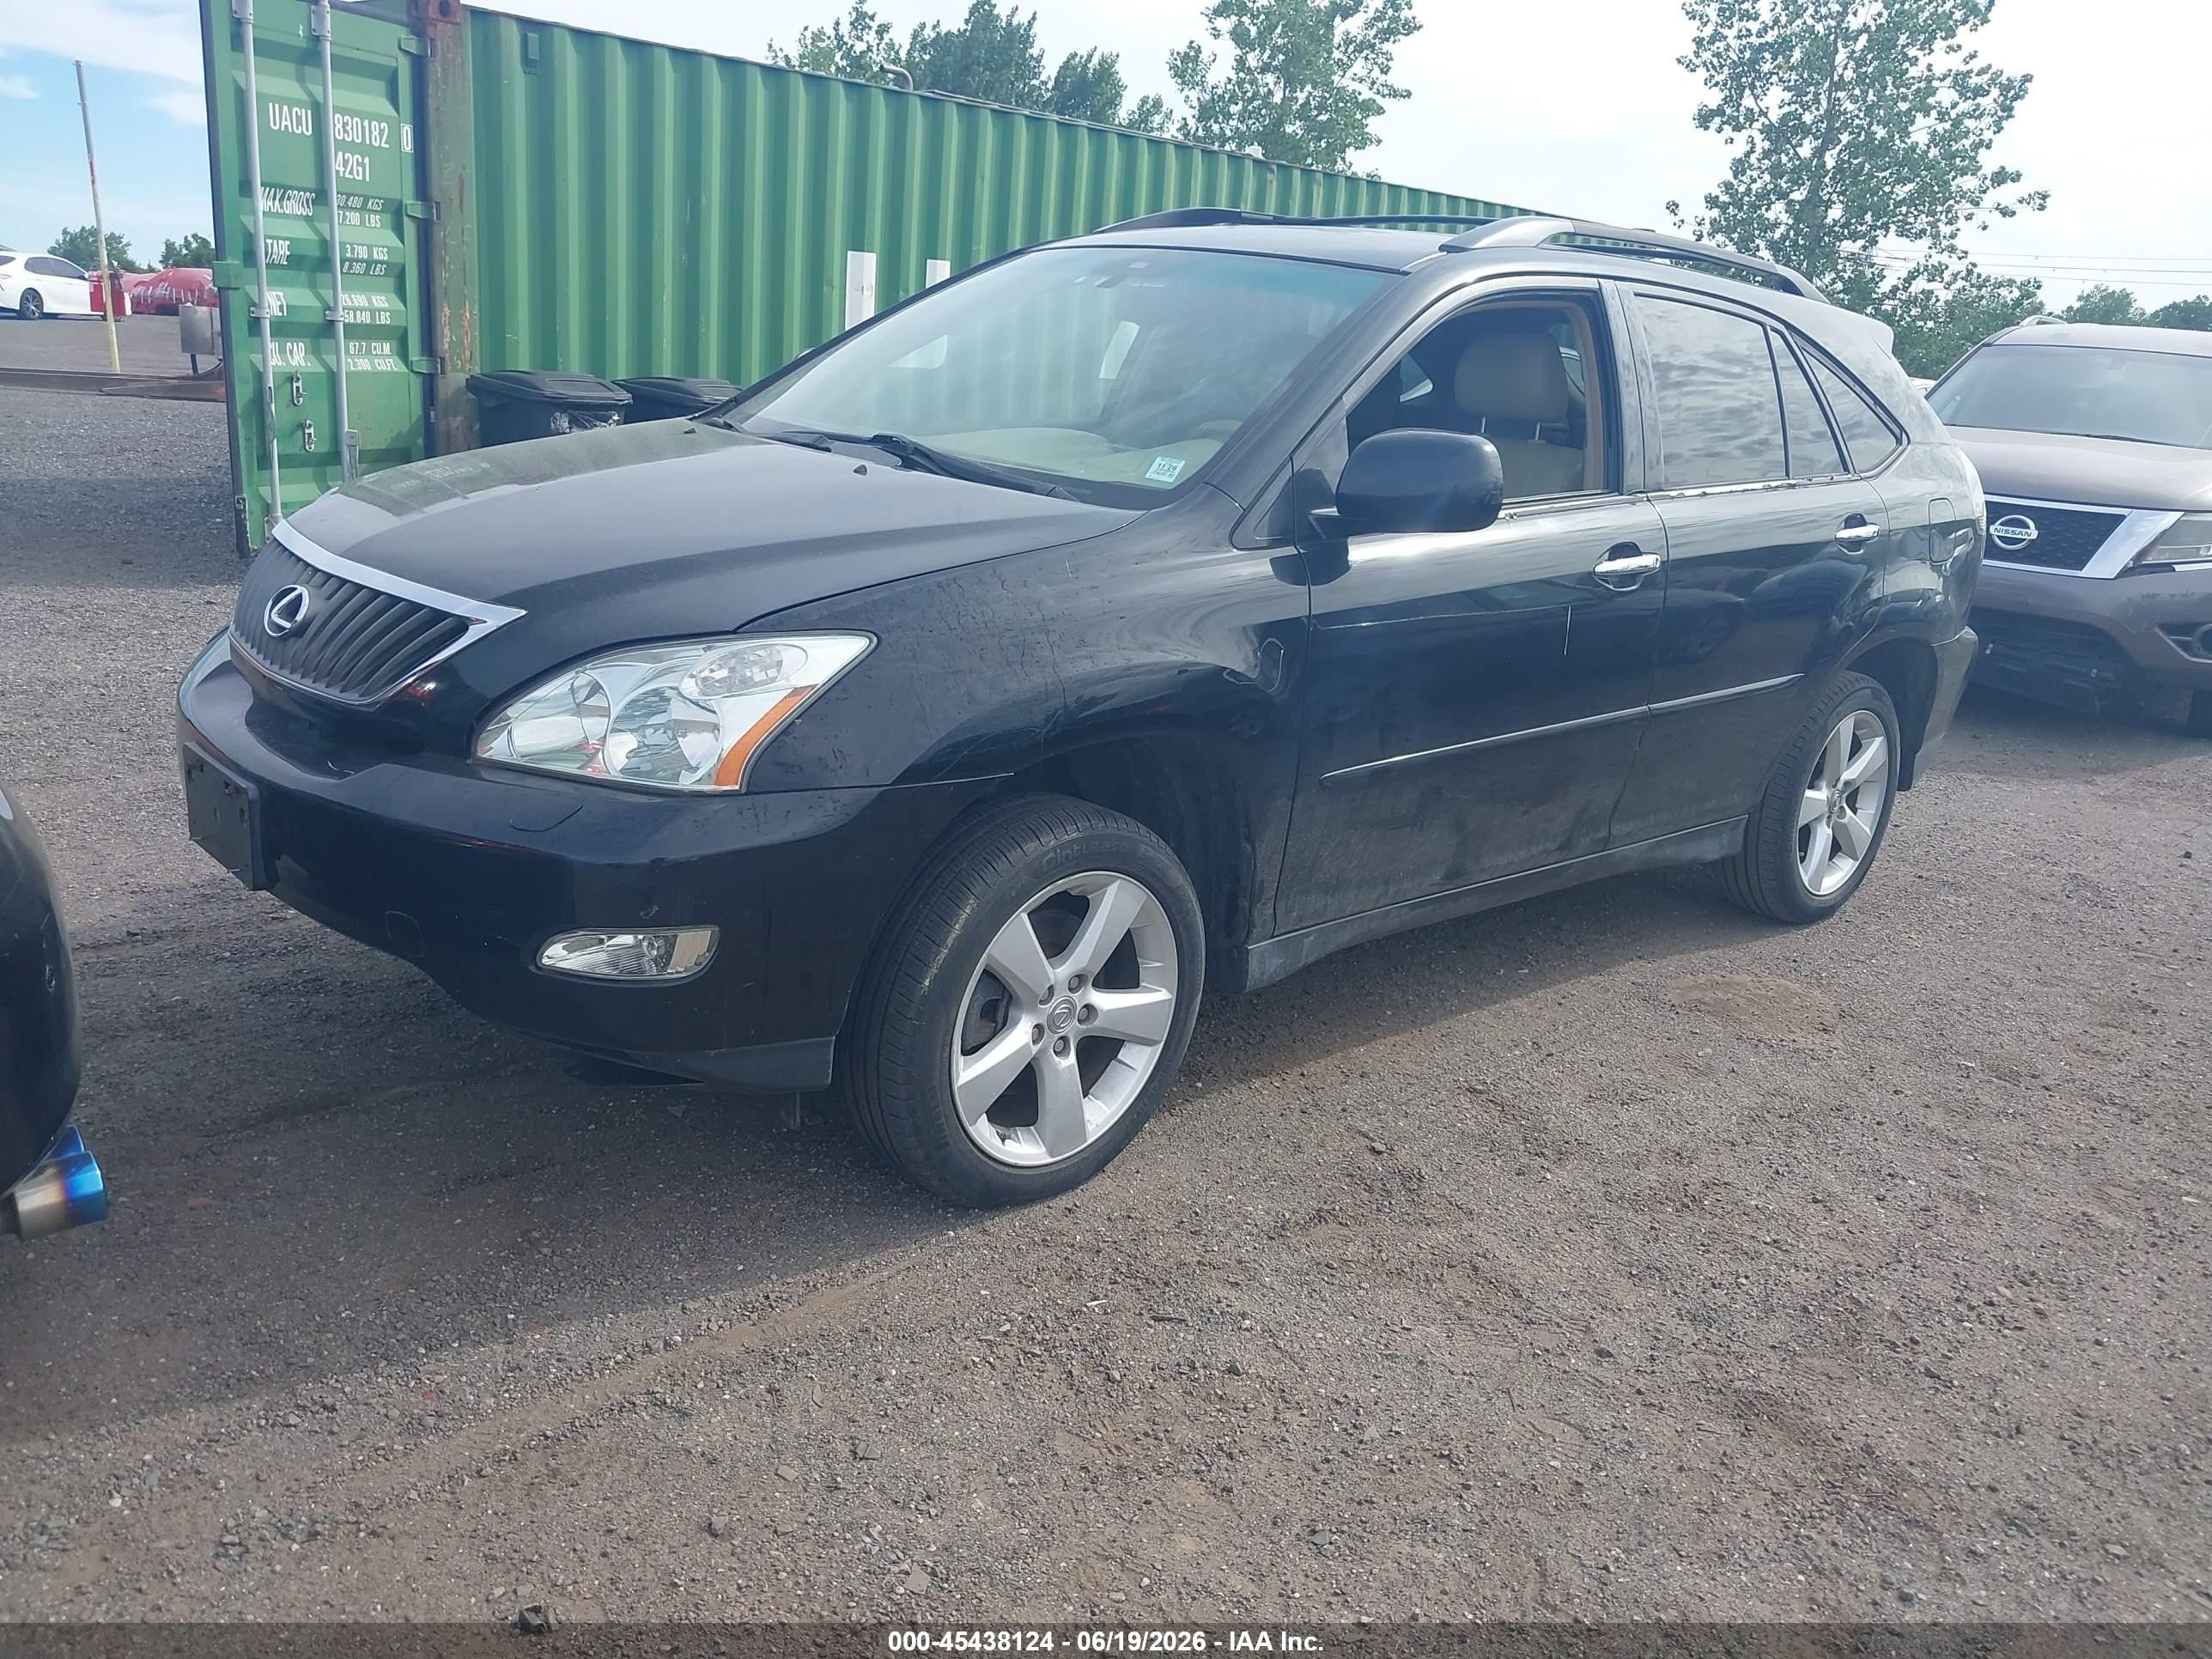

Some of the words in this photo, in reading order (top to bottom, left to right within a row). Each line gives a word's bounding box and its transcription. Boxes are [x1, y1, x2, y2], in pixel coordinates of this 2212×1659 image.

[269, 102, 313, 136] UACU
[334, 113, 390, 149] 830182
[403, 125, 412, 151] 0
[335, 151, 370, 182] 42G1
[367, 198, 384, 211] KGS
[337, 210, 361, 226] 7.200
[365, 213, 381, 228] LBS
[265, 239, 290, 265] TARE
[345, 244, 368, 259] 3.790
[373, 246, 388, 260] KGS
[343, 261, 367, 274] 8.360
[369, 263, 386, 276] LBS
[266, 291, 287, 317] NET
[370, 295, 389, 308] KGS
[343, 309, 371, 324] 58.840
[375, 311, 391, 325] LBS
[286, 342, 311, 367] CAP.
[349, 342, 366, 355] 67.7
[347, 358, 372, 371] 2.390
[1993, 526, 2033, 538] NISSAN
